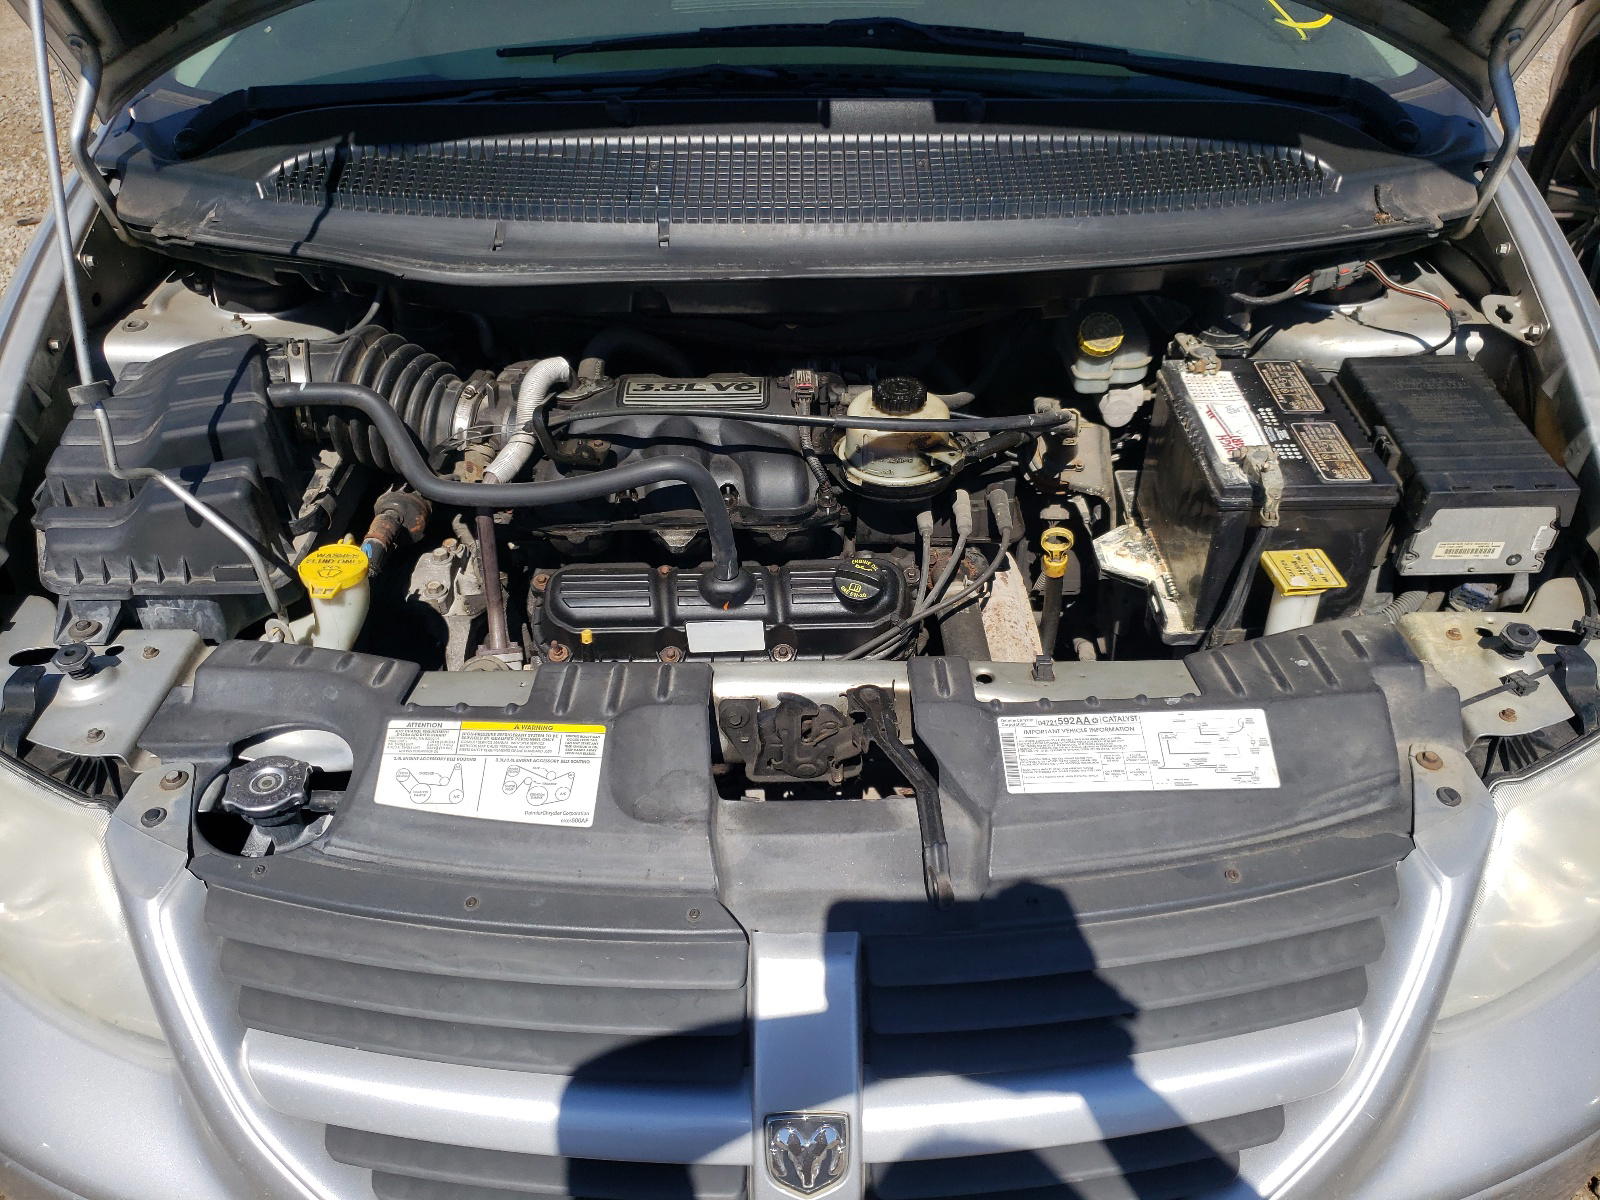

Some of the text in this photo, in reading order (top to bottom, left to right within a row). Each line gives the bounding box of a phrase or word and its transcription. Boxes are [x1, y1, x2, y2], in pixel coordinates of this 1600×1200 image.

[632, 382, 757, 392] 3.8L V6
[1101, 715, 1138, 723] CATALYST
